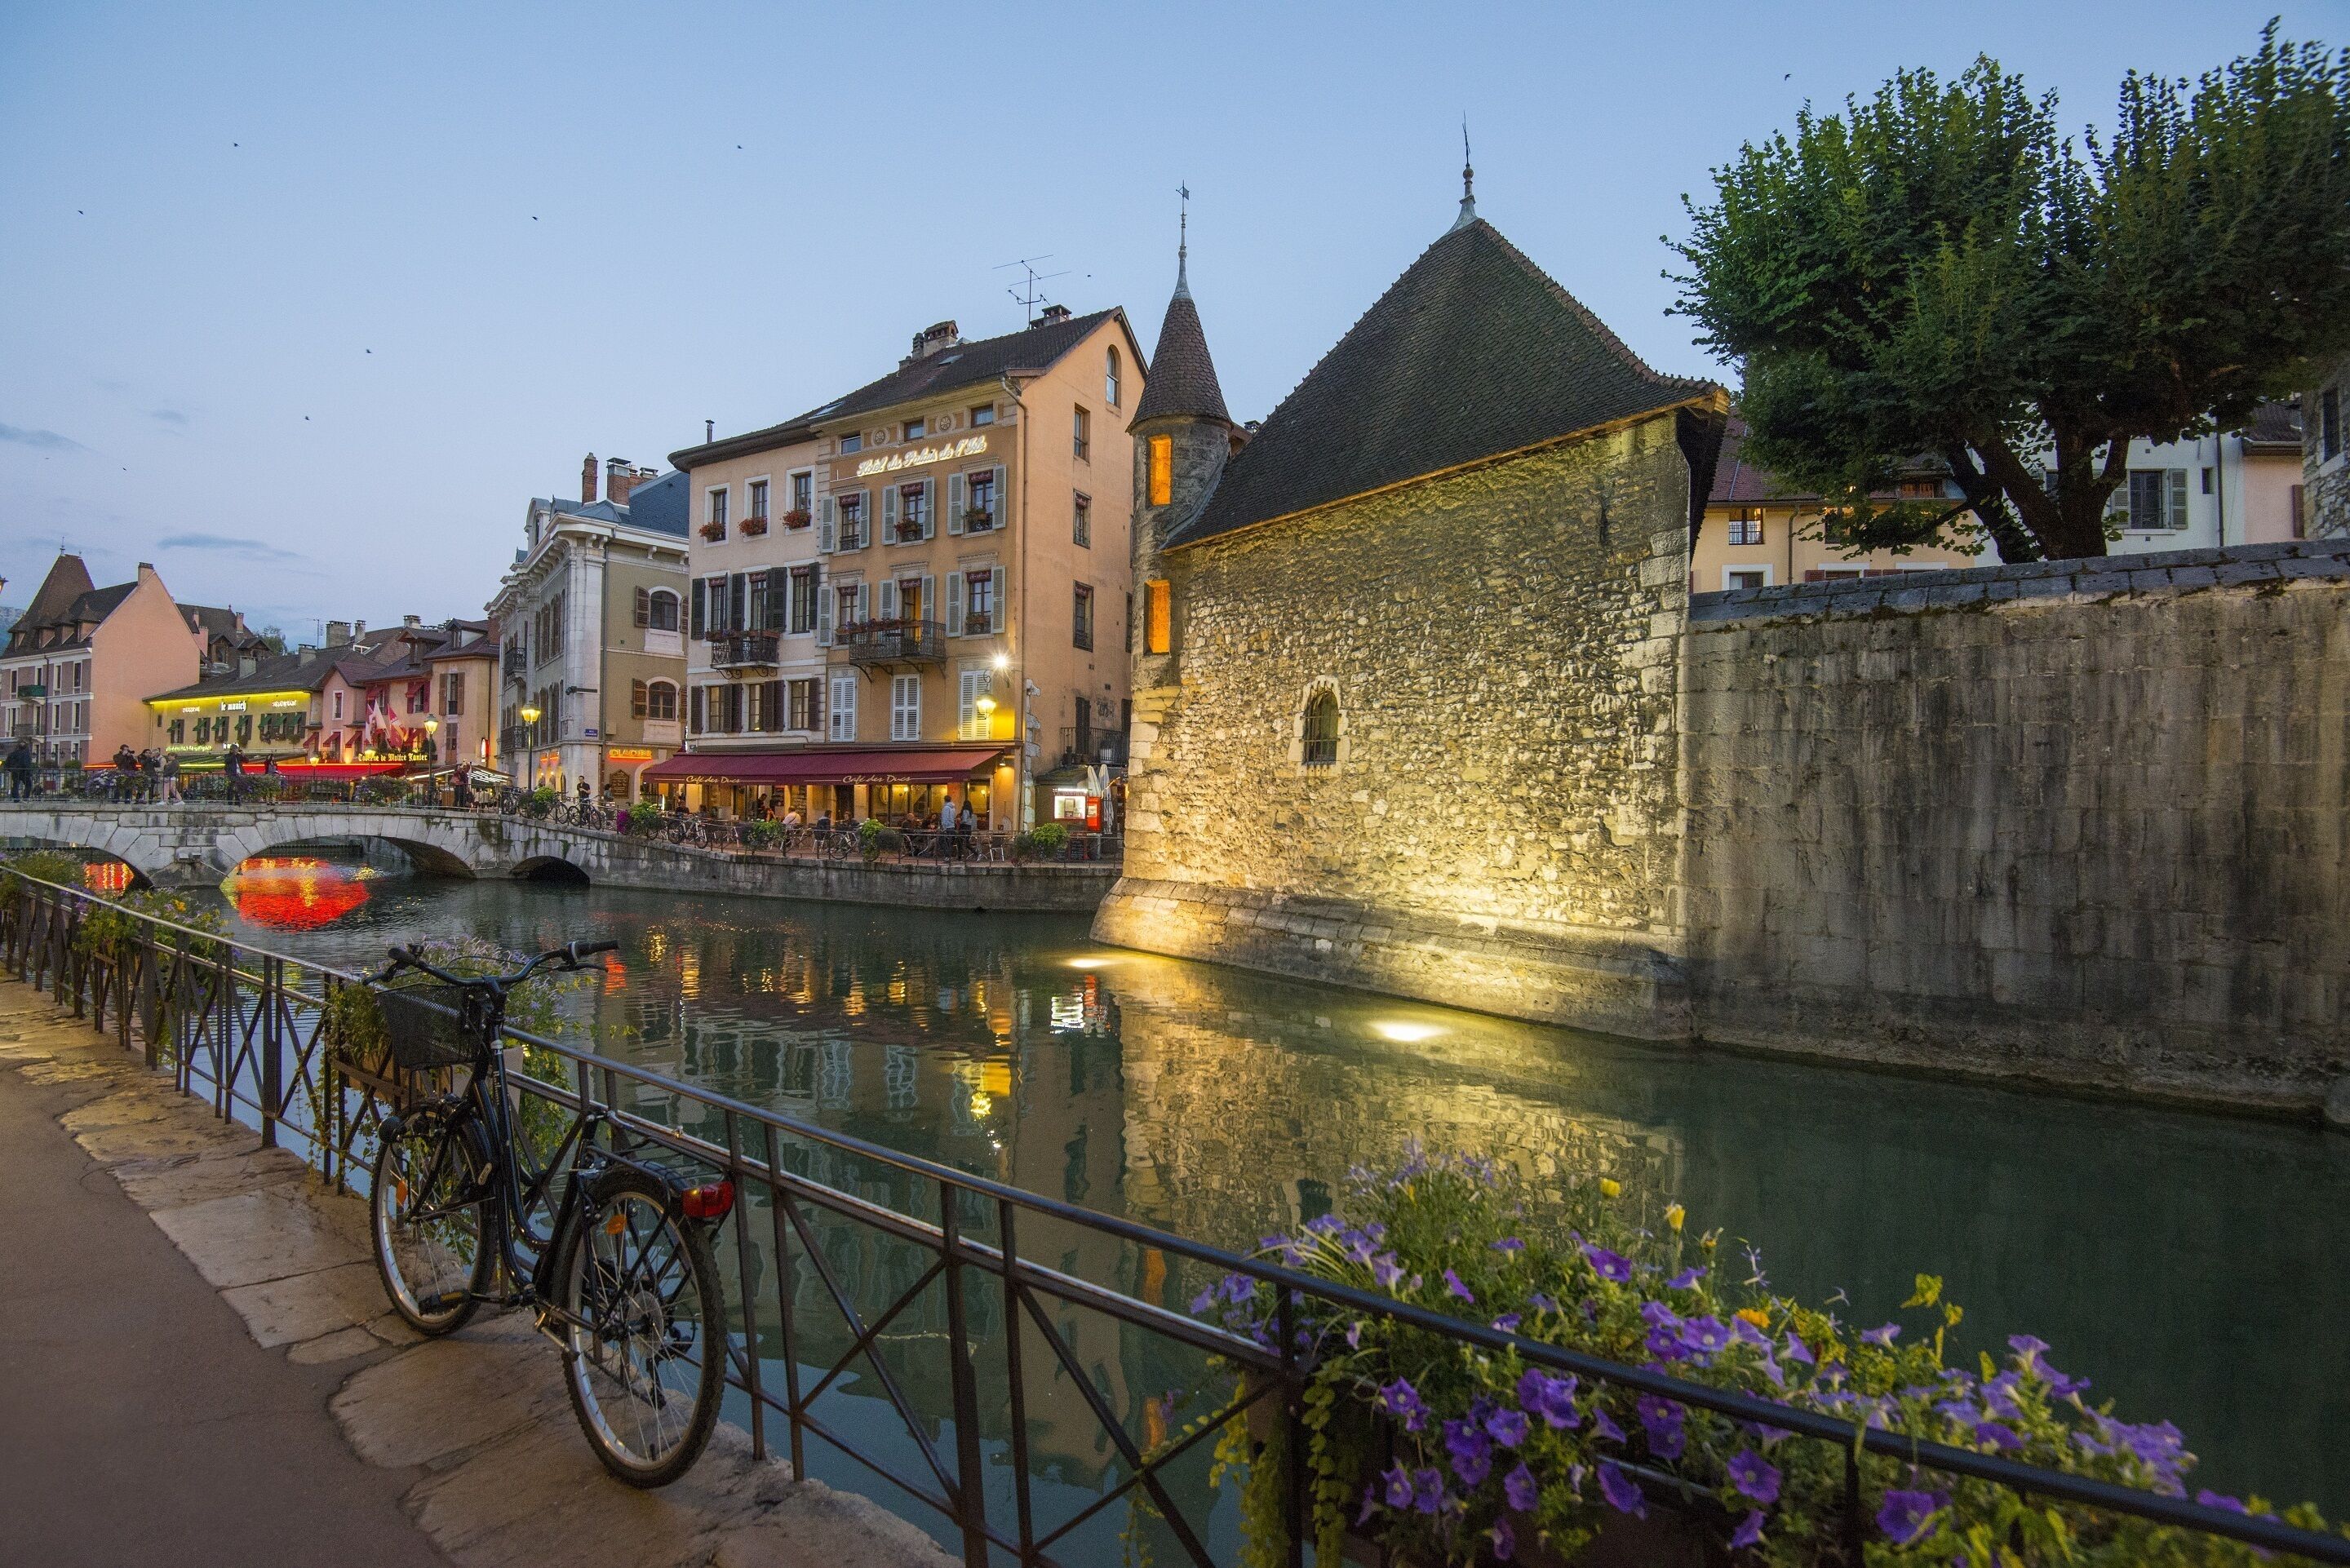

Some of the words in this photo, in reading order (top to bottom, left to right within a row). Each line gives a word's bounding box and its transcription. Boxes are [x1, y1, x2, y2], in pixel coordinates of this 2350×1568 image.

[887, 454, 902, 471] du
[903, 446, 938, 467] Palais
[939, 443, 954, 461] de
[686, 775, 703, 784] Café
[703, 775, 719, 783] des
[721, 776, 741, 784] Ducs
[842, 774, 865, 783] Café
[866, 774, 885, 783] des
[886, 774, 911, 783] Ducs
